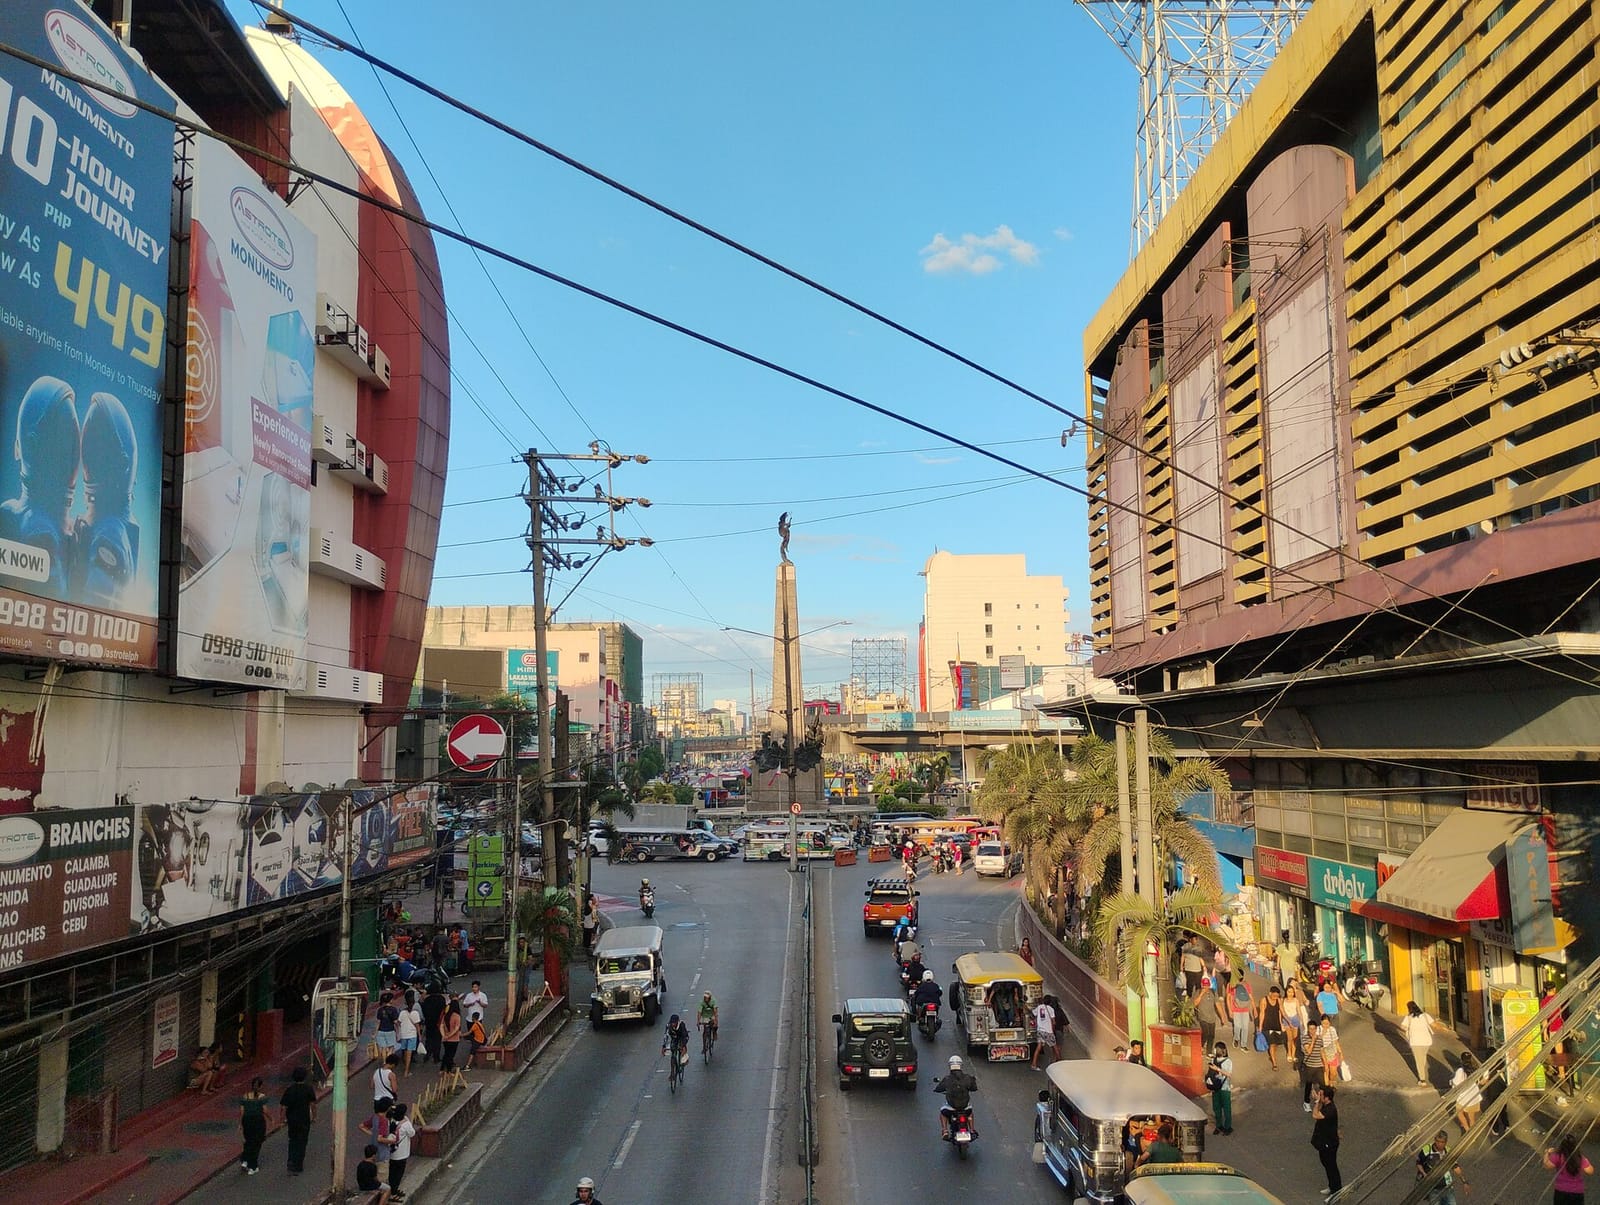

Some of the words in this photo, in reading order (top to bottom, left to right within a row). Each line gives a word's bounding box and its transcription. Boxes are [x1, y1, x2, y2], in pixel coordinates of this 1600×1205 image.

[41, 68, 135, 159] MONUMENTO
[44, 202, 72, 230] PHP
[60, 168, 165, 265] JOURNEY
[19, 225, 41, 252] As
[19, 261, 41, 289] As
[231, 238, 294, 302] MONUMENTO
[54, 240, 165, 369] 449
[26, 323, 62, 352] anytime
[64, 341, 83, 361] from
[85, 353, 117, 384] Monday
[117, 372, 126, 384] to
[127, 375, 162, 404] Thursday
[253, 403, 299, 447] Experience
[10, 552, 44, 573] NOW!
[51, 607, 89, 636] 510
[93, 614, 141, 643] 1000
[202, 633, 243, 658] 0998
[245, 641, 268, 662] 510
[50, 816, 131, 848] BRANCHES
[65, 855, 110, 874] CALAMBA
[64, 872, 118, 894] GUADALUPE
[63, 892, 109, 914] DIVISORIA
[62, 915, 88, 934] CEBU
